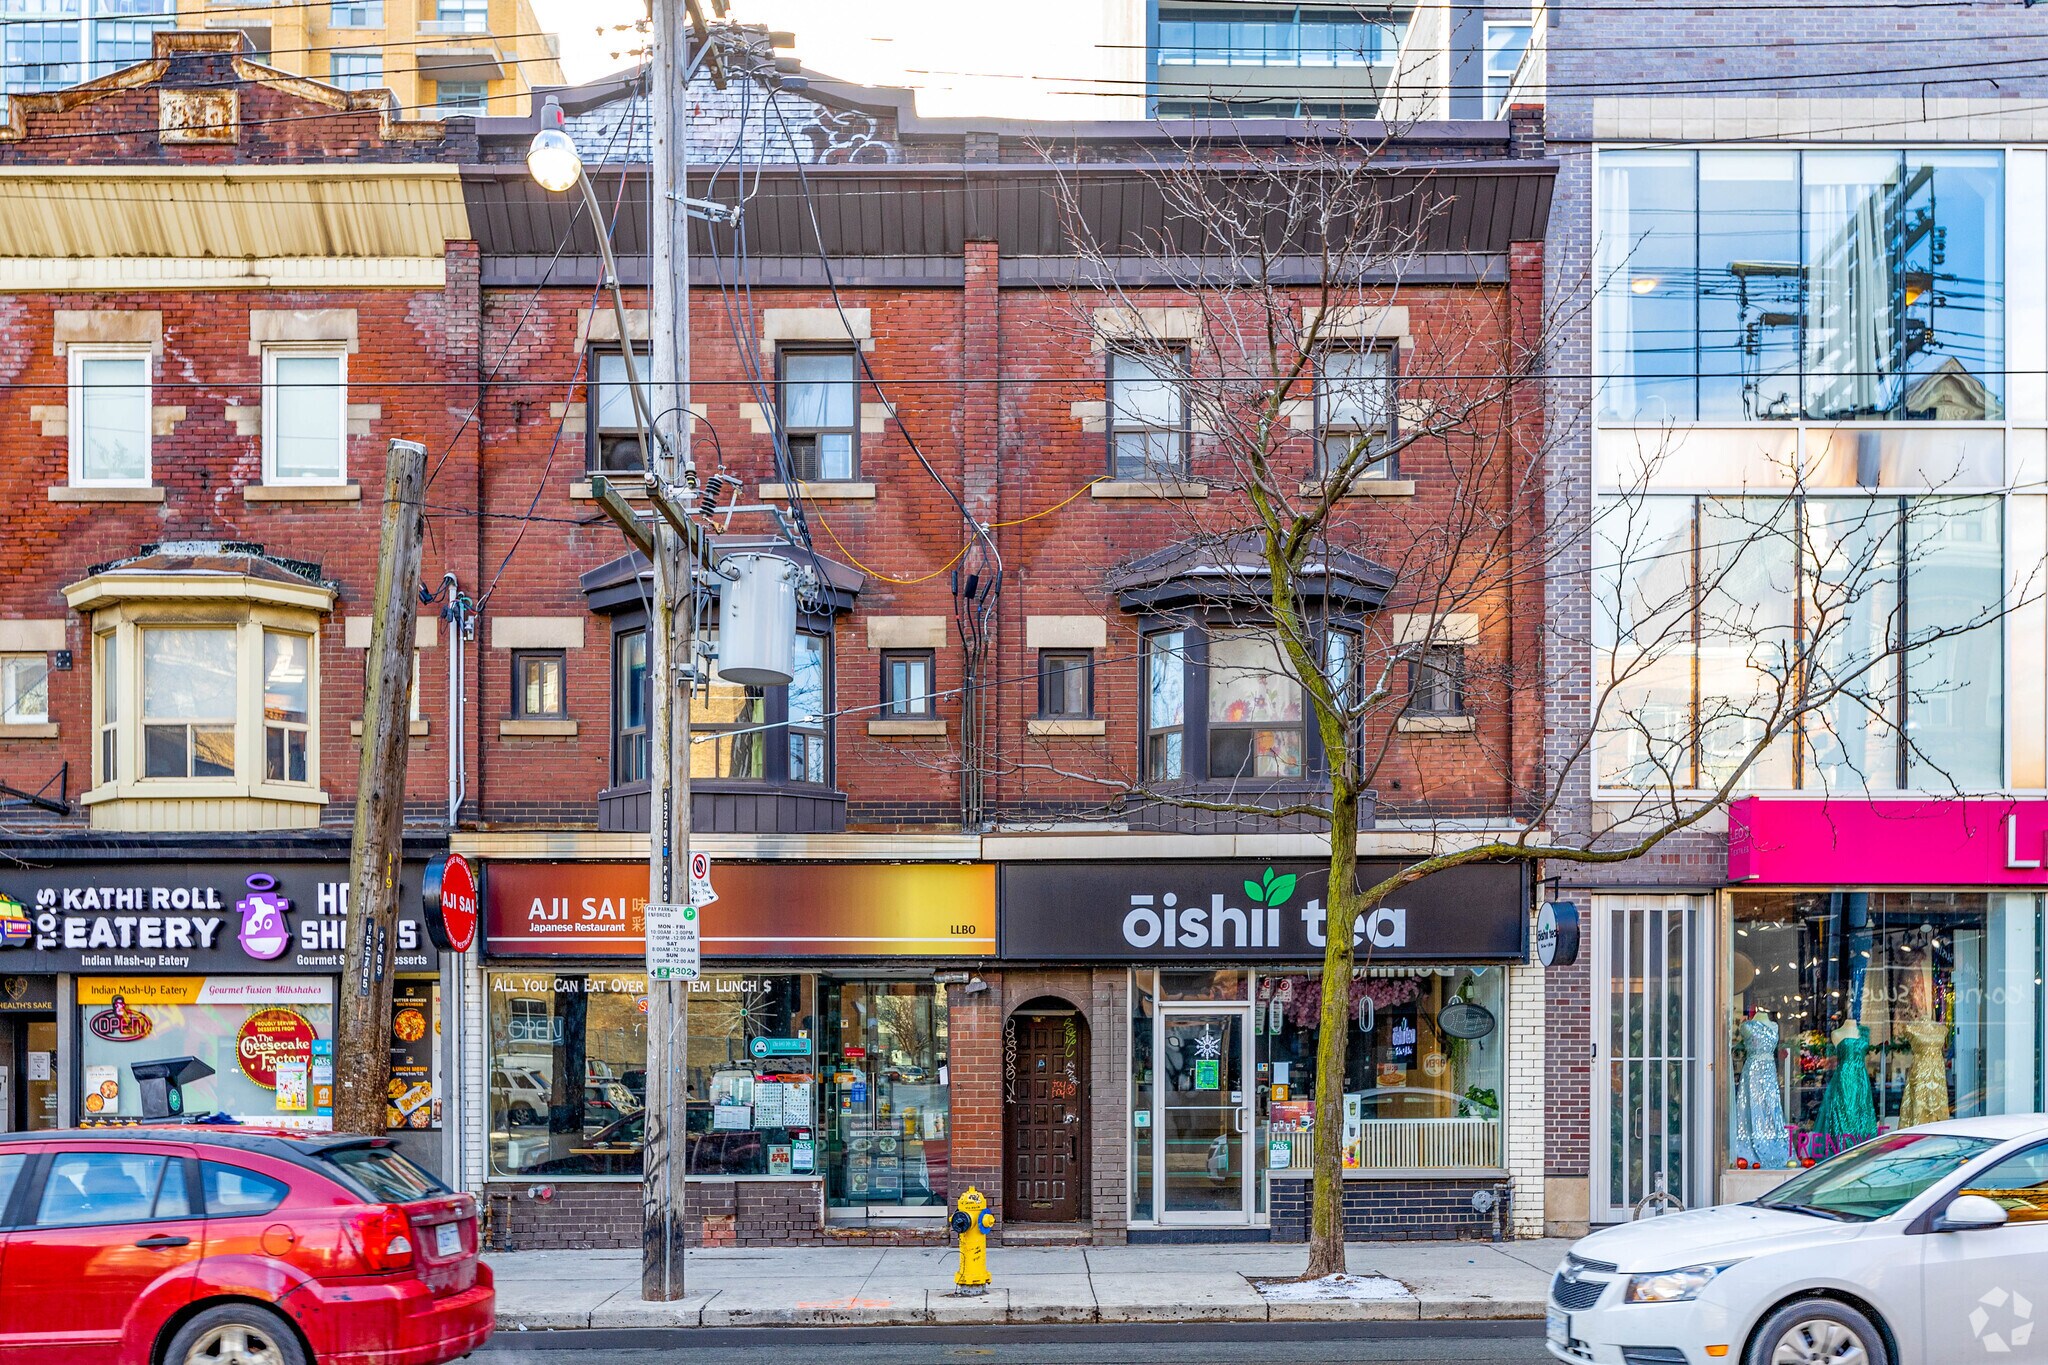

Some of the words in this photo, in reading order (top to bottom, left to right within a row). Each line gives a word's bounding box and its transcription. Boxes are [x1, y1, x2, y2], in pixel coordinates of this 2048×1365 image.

[63, 887, 143, 910] KATHI
[151, 887, 222, 910] ROLL
[443, 891, 457, 909] AJI
[459, 895, 475, 914] SAI
[528, 897, 569, 920] AJI
[582, 897, 626, 920] SAI
[64, 916, 220, 949] EATERY
[302, 919, 416, 950] SHS
[529, 923, 573, 933] Japanese
[575, 923, 626, 932] Restaurant
[950, 925, 976, 935] LLBO
[82, 955, 112, 966] Indian
[114, 955, 156, 968] Mash-up
[158, 955, 190, 968] Eatery
[297, 955, 337, 966] Gourmet
[394, 955, 427, 966] esserts
[670, 967, 692, 976] 4302
[91, 986, 117, 995] Indian
[119, 986, 157, 996] Mash-Up
[160, 986, 188, 996] Eatery
[209, 985, 244, 996] Gourmet
[245, 985, 272, 994] Fusion
[275, 985, 322, 994] Milkshakes
[494, 979, 517, 993] ALL
[522, 979, 548, 993] YOU
[553, 979, 578, 993] CAN
[584, 979, 606, 993] EAT
[611, 979, 644, 993] OVER
[687, 979, 710, 993] TEM
[716, 979, 757, 993] LUNCH
[763, 979, 772, 993] $
[33, 1002, 53, 1010] SAKE
[98, 1018, 143, 1033] OPEN
[509, 1020, 562, 1038] OPEN
[257, 1034, 273, 1042] The
[241, 1036, 310, 1059] Cheesecake
[256, 1050, 310, 1070] Factory
